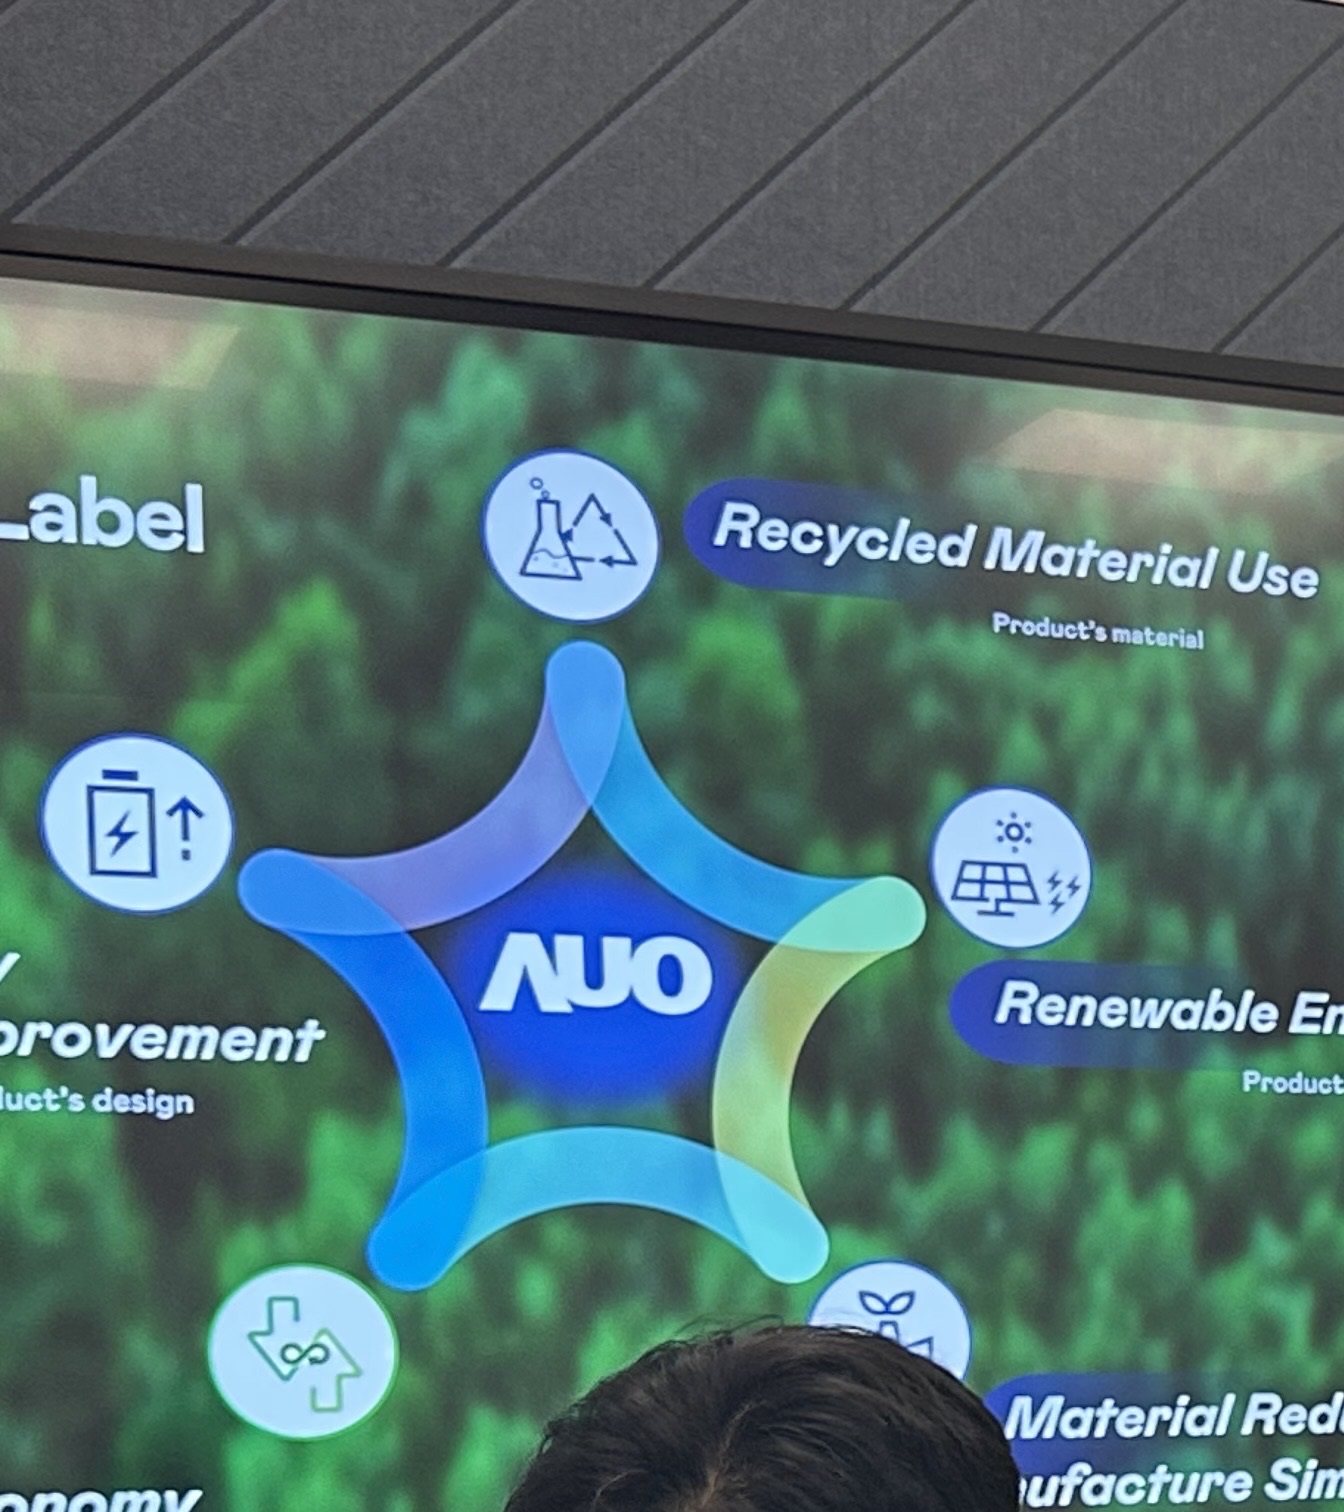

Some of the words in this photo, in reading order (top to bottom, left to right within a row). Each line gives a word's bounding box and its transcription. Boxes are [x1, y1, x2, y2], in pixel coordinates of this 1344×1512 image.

[713, 501, 978, 569] Recycled
[984, 527, 1220, 592] Material
[1227, 549, 1320, 598] Use
[992, 612, 1107, 642] Product's
[1112, 622, 1204, 650] material
[478, 930, 713, 1016] AUO
[994, 979, 1279, 1033] Renewable
[0, 1086, 85, 1113] uct's
[92, 1087, 195, 1120] design
[1005, 1393, 1236, 1440] Material
